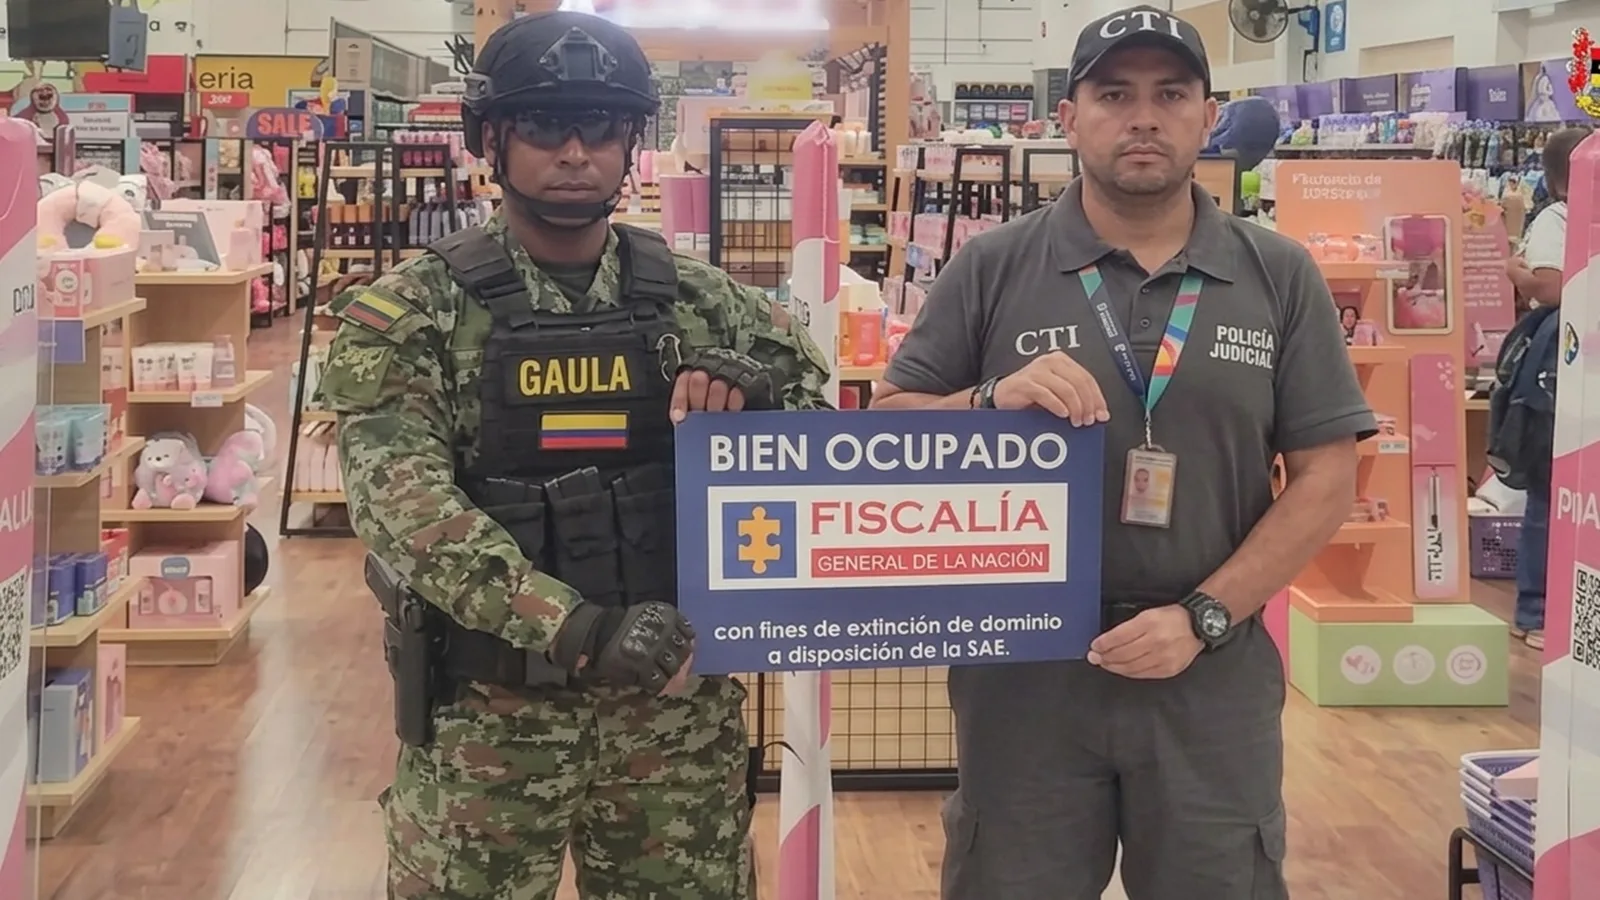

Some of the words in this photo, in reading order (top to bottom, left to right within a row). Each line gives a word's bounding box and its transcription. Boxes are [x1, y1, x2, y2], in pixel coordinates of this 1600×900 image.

[1100, 10, 1183, 40] CTI
[199, 66, 254, 89] eria
[257, 112, 311, 136] SALE
[1015, 324, 1081, 356] CTI
[1209, 342, 1273, 369] JUDICIAL
[519, 355, 631, 396] GAULA
[710, 434, 808, 472] BIEN
[825, 432, 1068, 471] OCUPADO
[810, 490, 1049, 535] FISCALÍA
[817, 555, 908, 572] GENERAL
[913, 553, 938, 570] DE
[944, 552, 967, 569] LA
[971, 548, 1044, 568] NACIÓN
[714, 625, 754, 640] con
[759, 620, 808, 639] fines
[813, 620, 841, 637] de
[847, 614, 941, 637] extinción
[947, 615, 974, 633] de
[980, 613, 1062, 632] dominio
[768, 650, 781, 664] a
[788, 641, 904, 667] disposición
[910, 642, 936, 659] de
[943, 641, 961, 658] la
[967, 639, 1010, 657] SAE.
